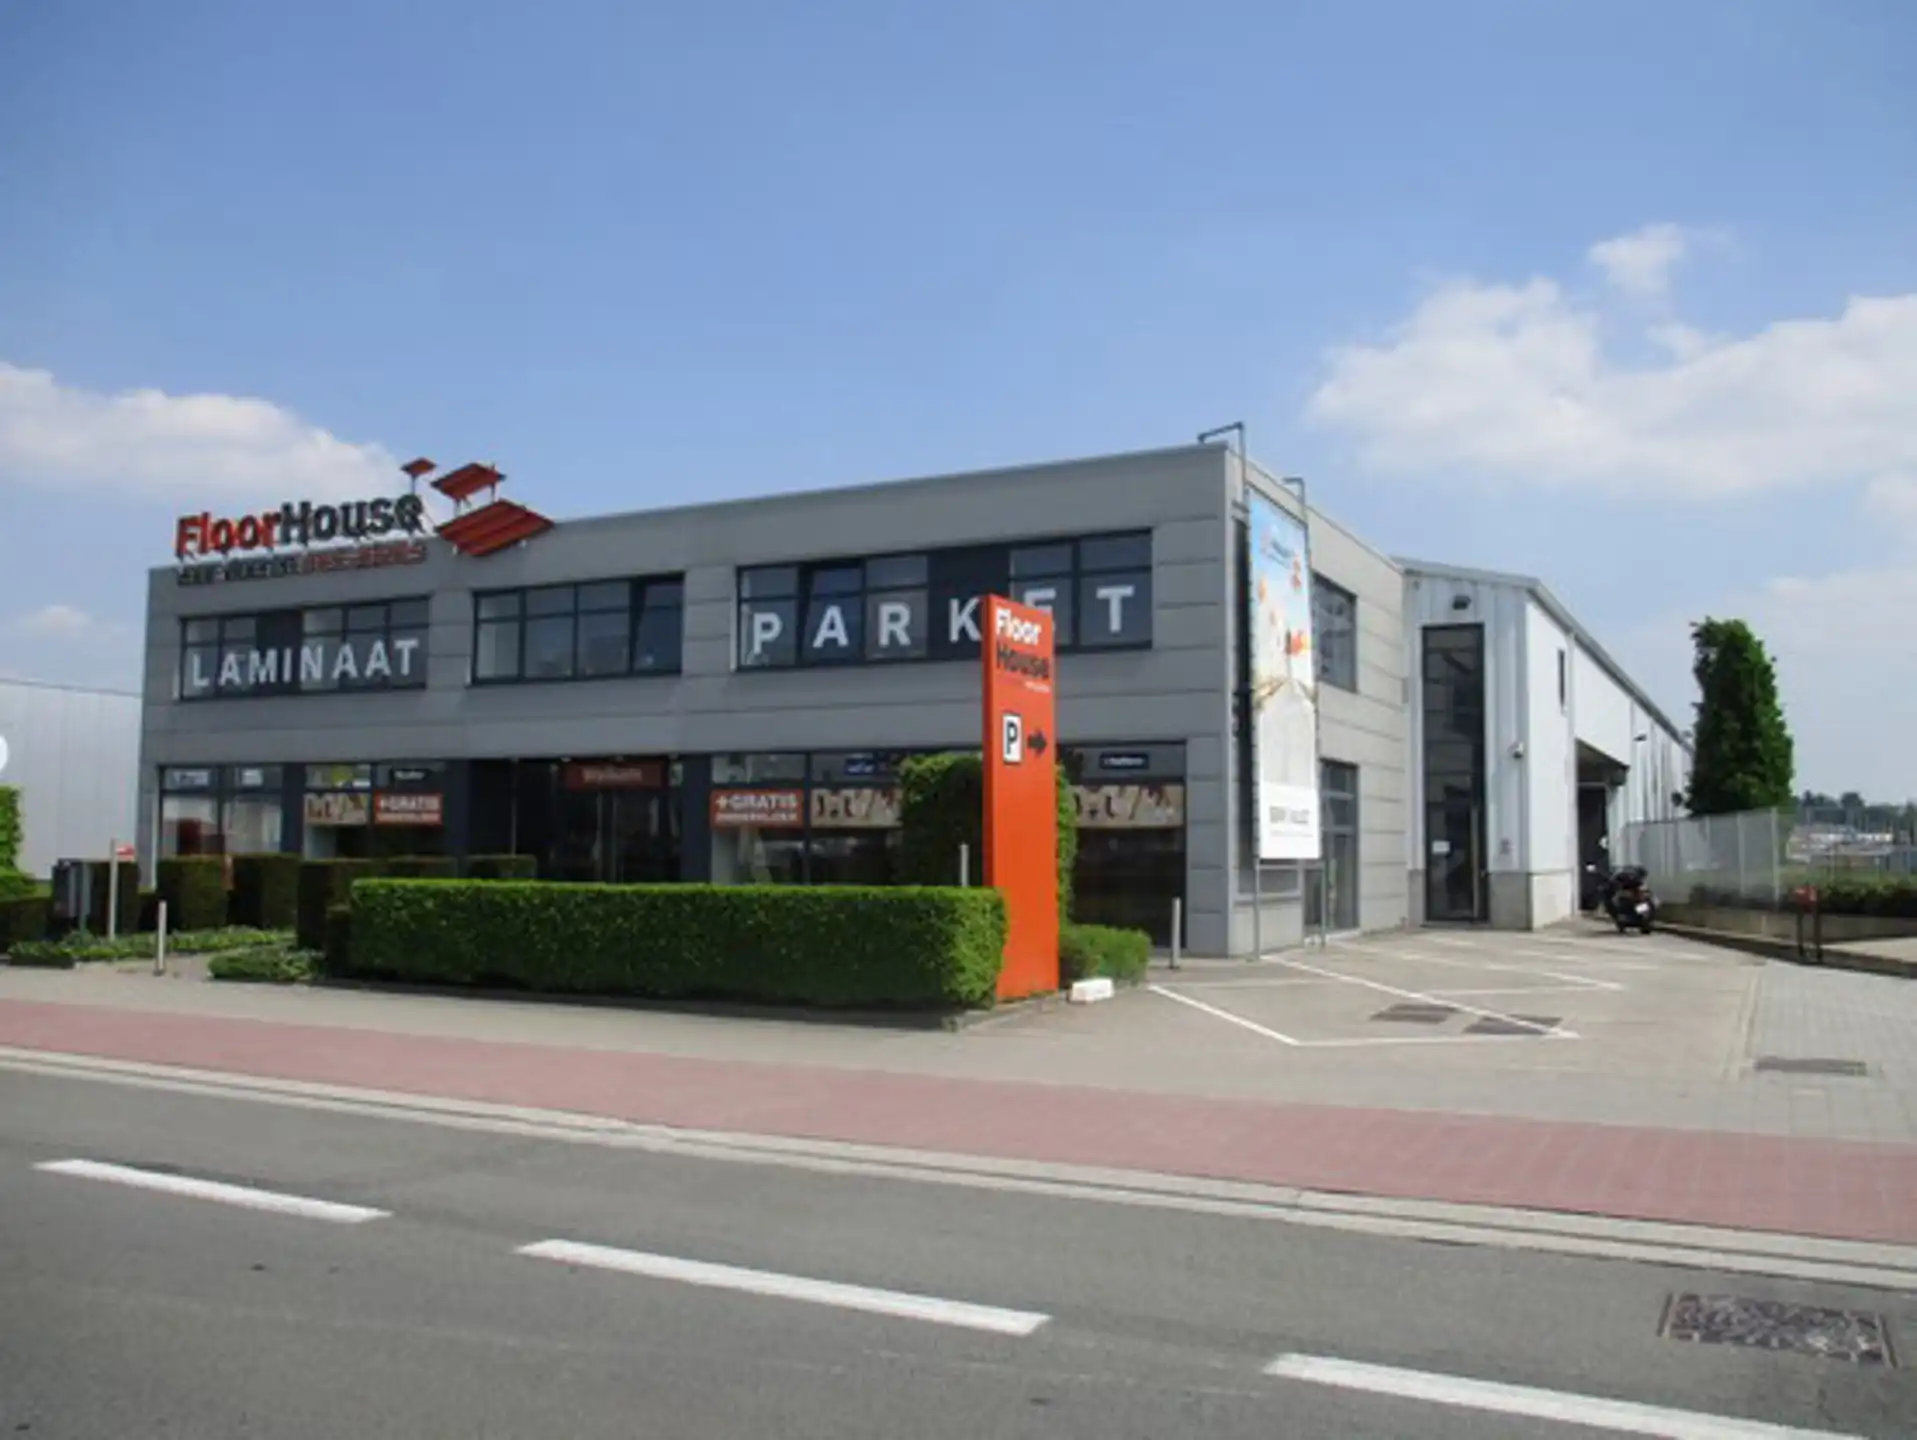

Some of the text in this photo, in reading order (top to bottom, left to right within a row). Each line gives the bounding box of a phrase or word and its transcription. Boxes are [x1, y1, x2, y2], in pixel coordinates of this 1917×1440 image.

[996, 607, 1042, 645] Floor
[192, 639, 419, 687] LAMINAAT
[996, 640, 1050, 680] House
[1006, 722, 1018, 754] P
